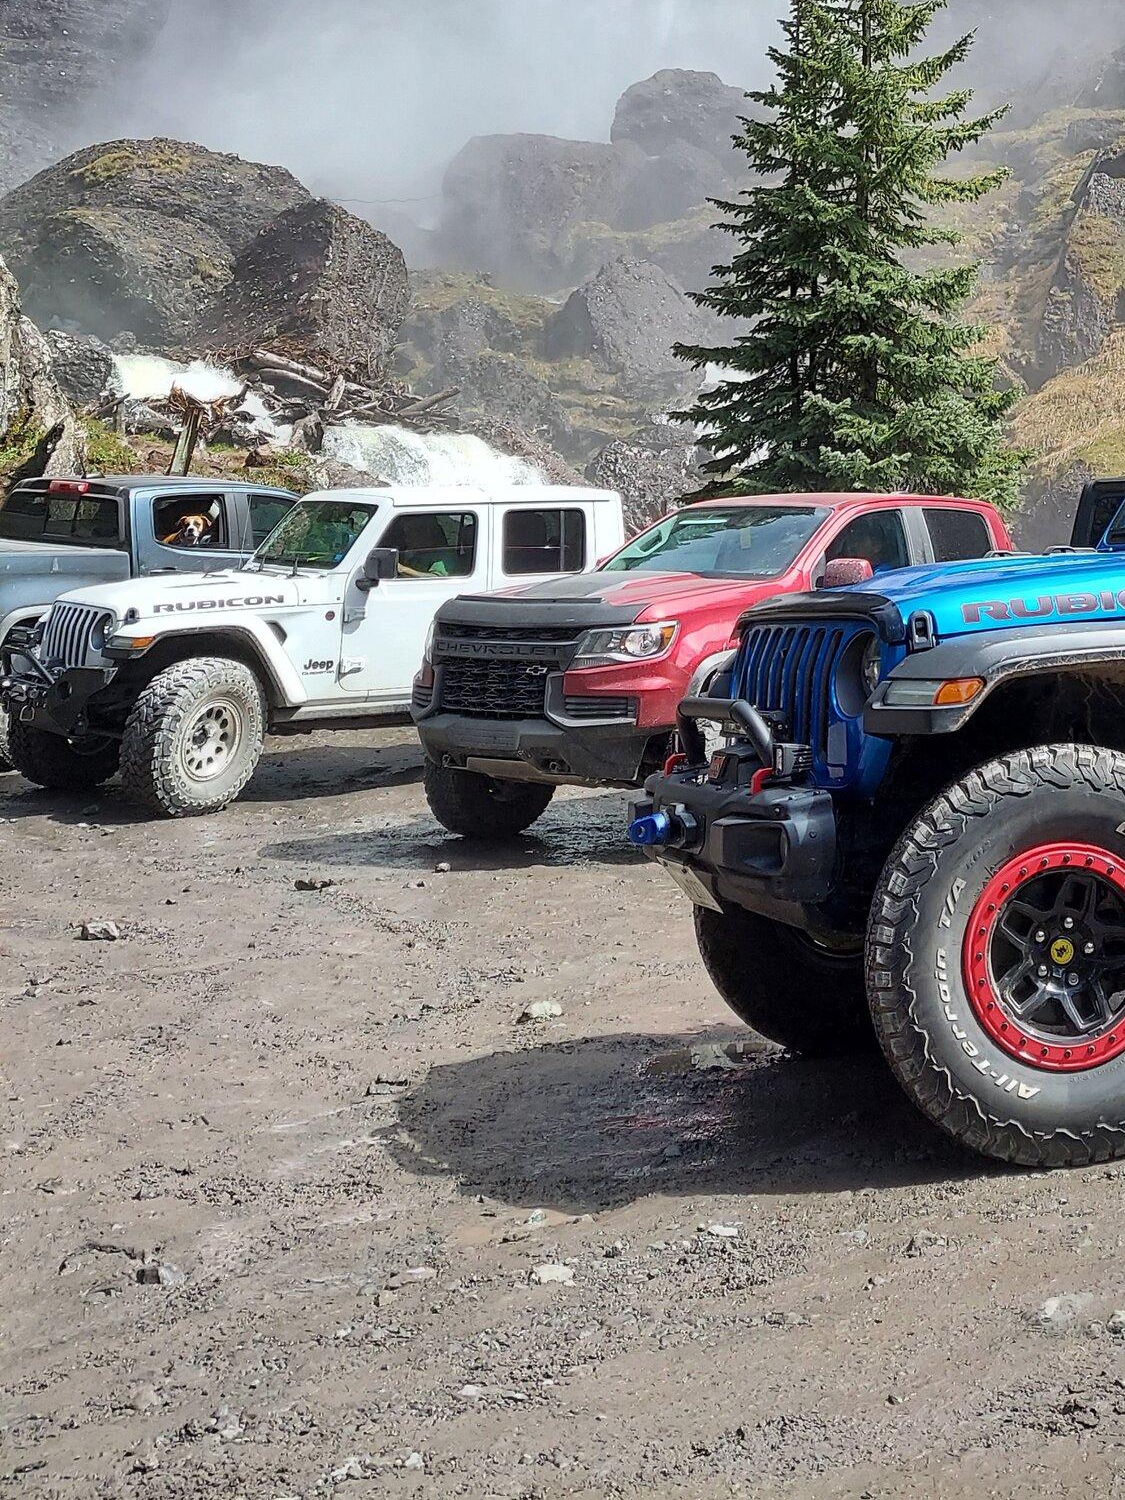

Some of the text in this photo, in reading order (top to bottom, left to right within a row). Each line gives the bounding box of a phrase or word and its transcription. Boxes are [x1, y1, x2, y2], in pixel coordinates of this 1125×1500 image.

[153, 594, 285, 613] RUBICON
[436, 641, 562, 656] CHEVROLET
[303, 658, 334, 671] Jeep
[934, 876, 1041, 1100] All-Terrain T/A
